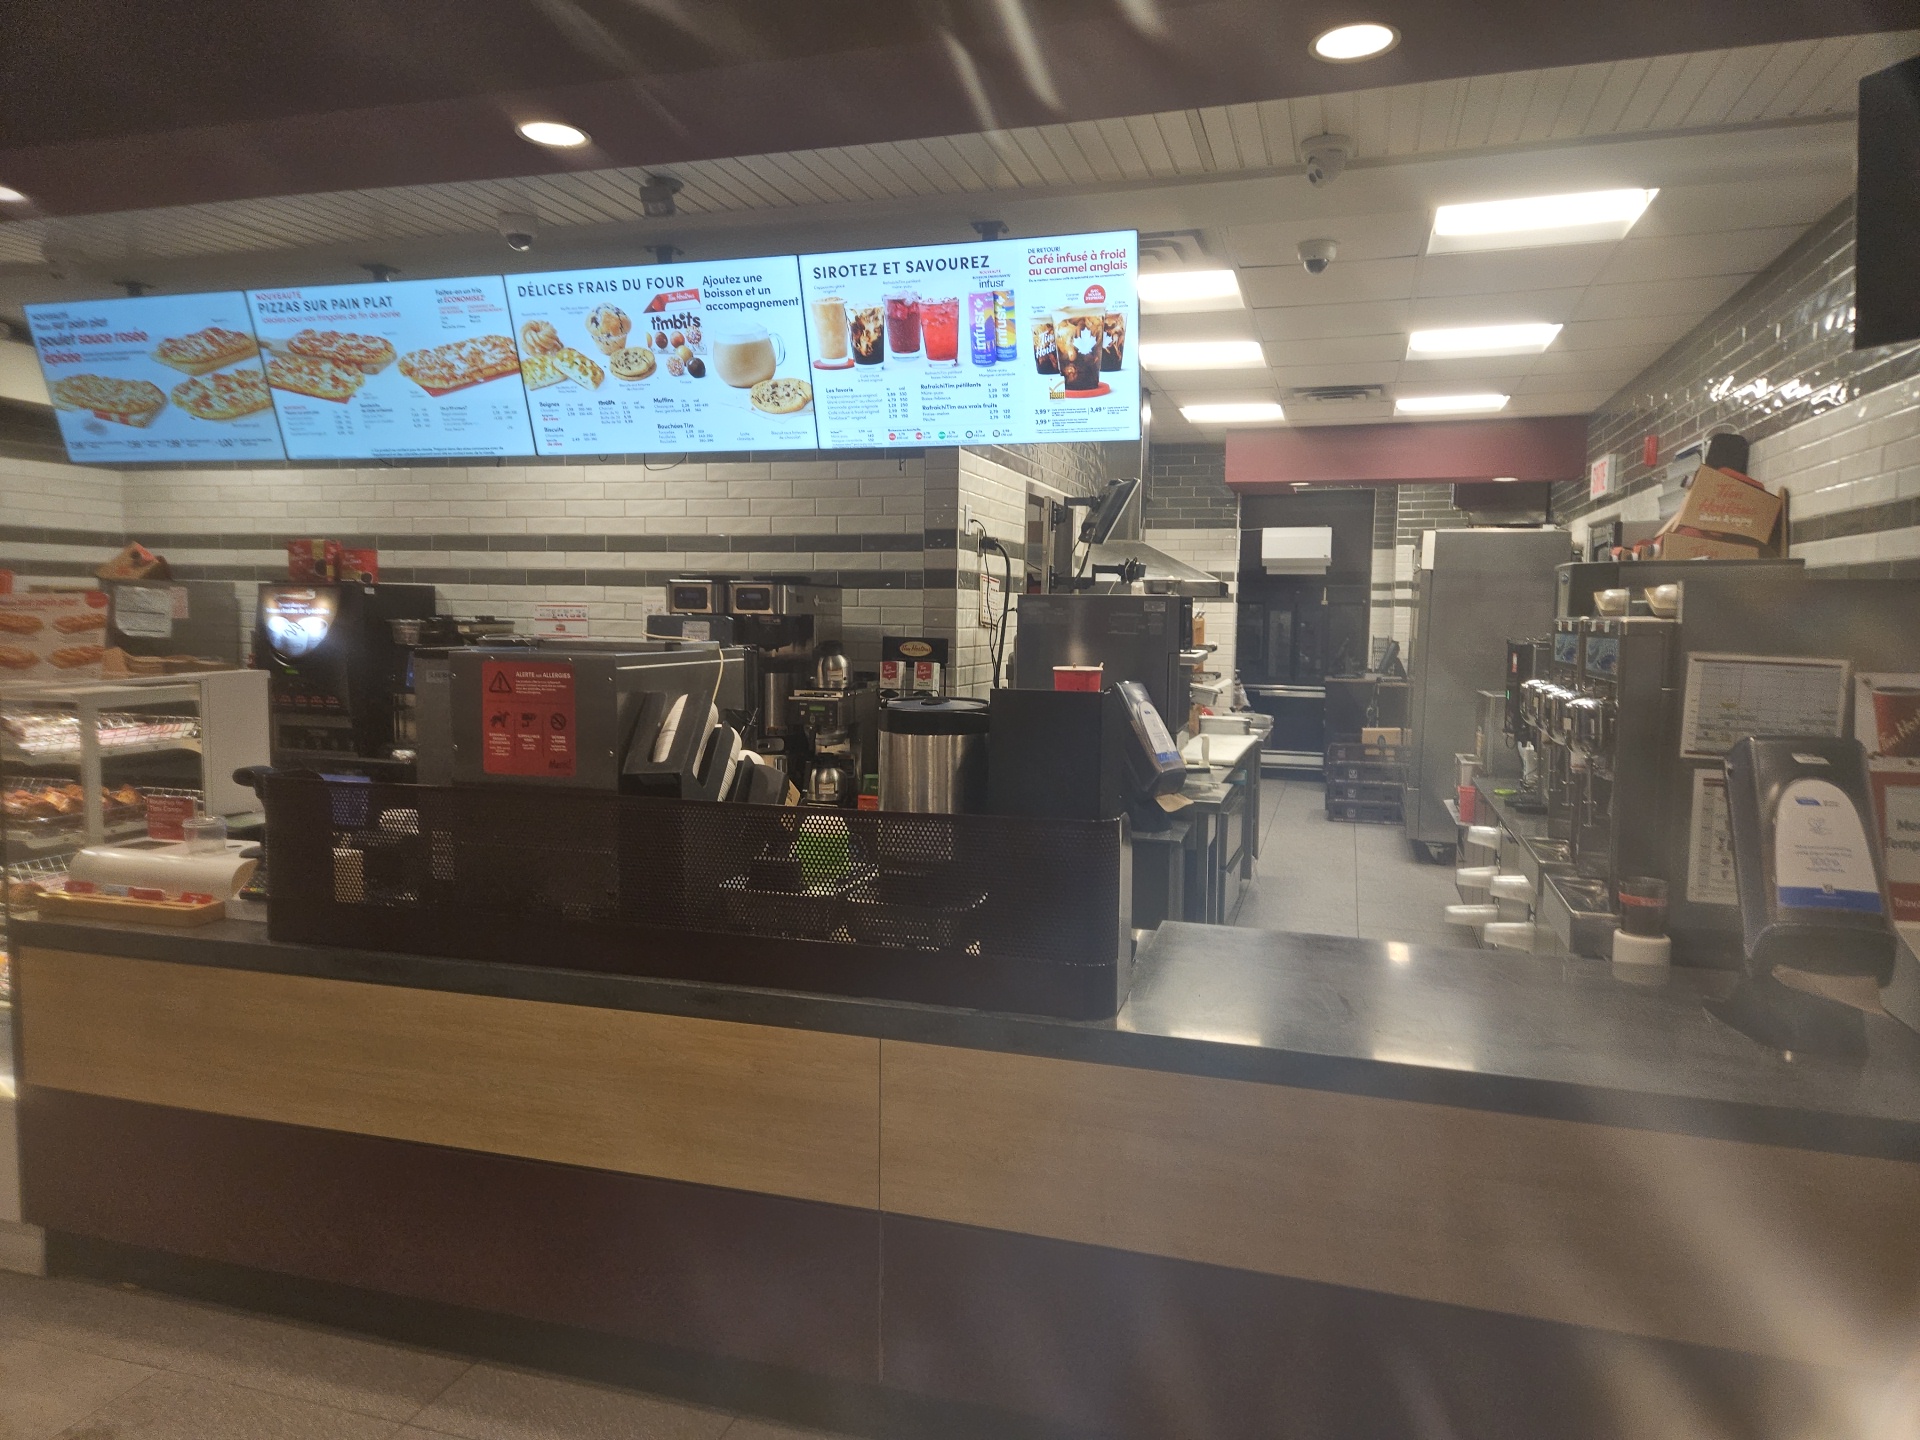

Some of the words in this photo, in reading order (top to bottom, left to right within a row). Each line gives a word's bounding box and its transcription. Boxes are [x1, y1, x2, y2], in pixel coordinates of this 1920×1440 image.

[1028, 253, 1054, 265] Café
[1056, 250, 1088, 263] infusé
[1090, 250, 1098, 260] à
[1100, 248, 1126, 260] froid
[813, 263, 878, 280] SIROTEZ
[883, 262, 900, 275] ET
[906, 255, 990, 274] SAVOUREZ
[1028, 268, 1042, 276] au
[1044, 263, 1087, 275] caramel
[1090, 260, 1128, 274] anglais
[518, 281, 574, 298] DÉLICES
[578, 280, 618, 294] FRAIS
[623, 278, 641, 291] DU
[646, 276, 684, 289] FOUR
[702, 275, 740, 288] Ajoutez
[743, 274, 762, 283] une
[979, 279, 1004, 288] infusr
[704, 288, 743, 298] boisson
[746, 286, 756, 296] et
[758, 287, 772, 295] un
[258, 301, 300, 314] PIZZAS
[303, 299, 328, 312] SUR
[331, 297, 361, 310] PAIN
[364, 296, 393, 308] PLAT
[706, 297, 800, 312] accompagnement
[651, 312, 701, 330] timbits
[1716, 483, 1744, 498] Tim
